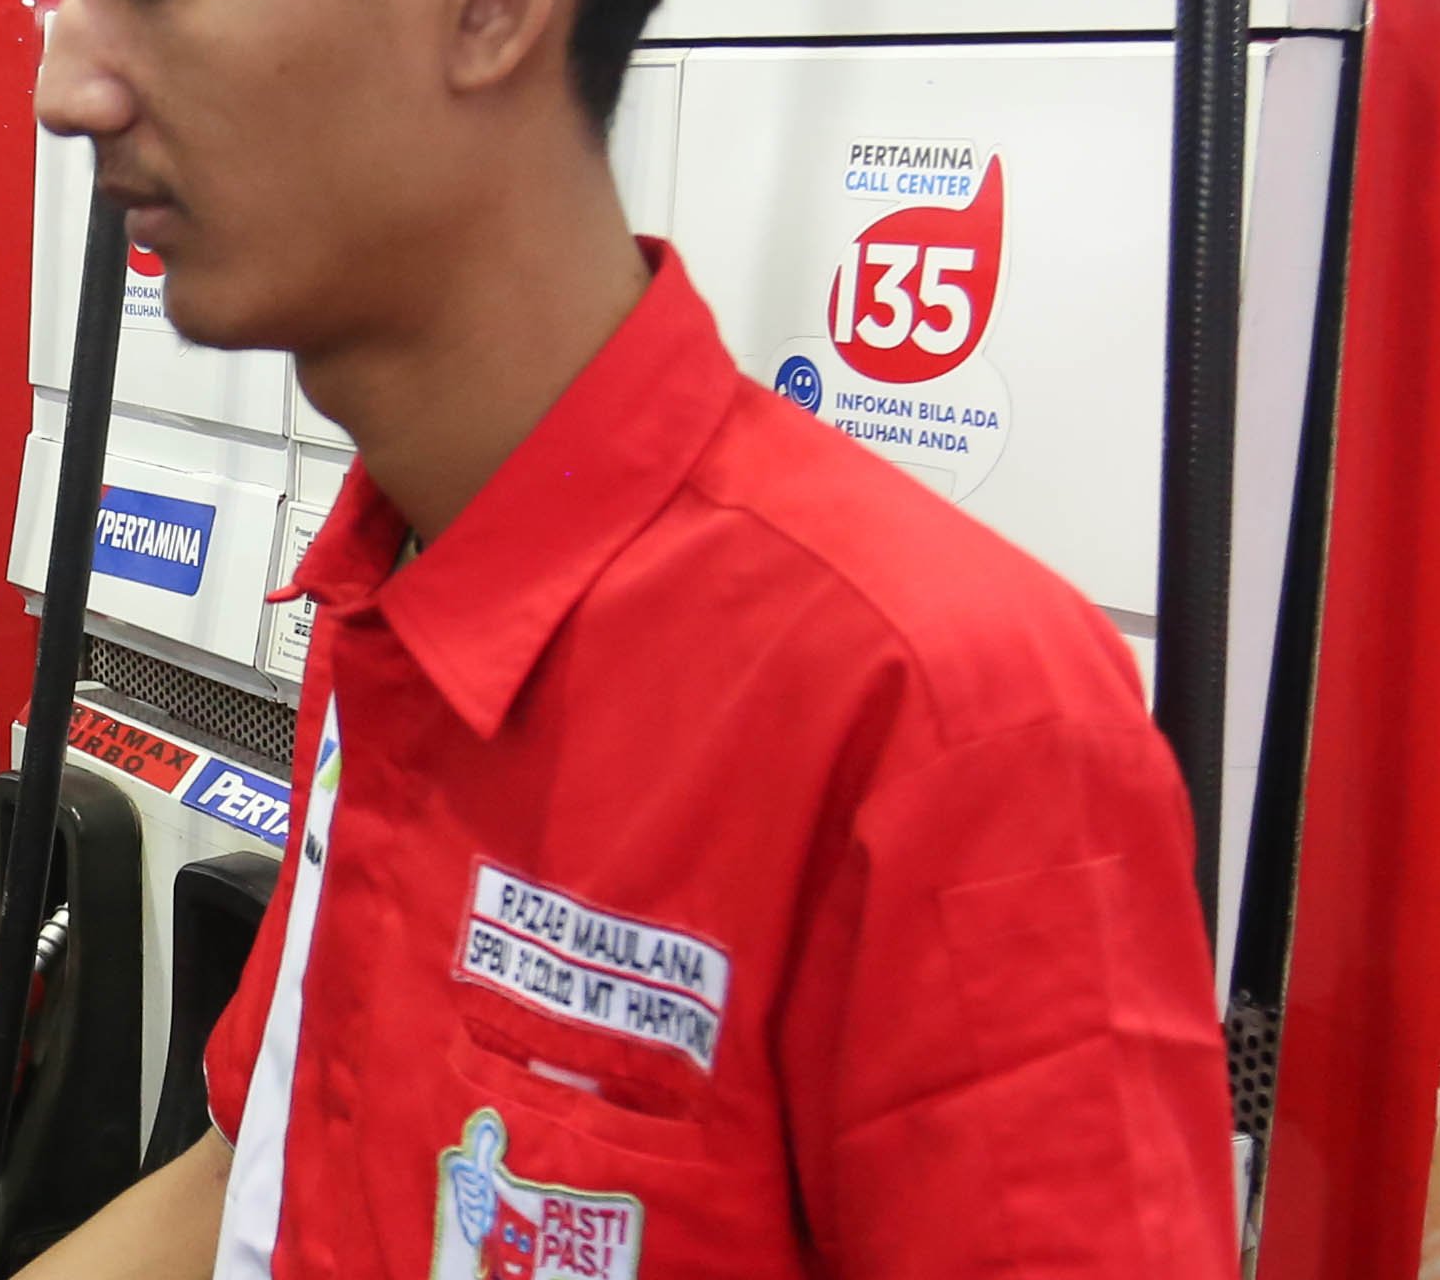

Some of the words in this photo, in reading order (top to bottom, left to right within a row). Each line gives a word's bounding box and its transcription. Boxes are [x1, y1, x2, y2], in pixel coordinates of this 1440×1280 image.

[850, 144, 973, 170] PERTAMINA
[845, 171, 889, 193] CALL
[897, 173, 971, 197] CENTER
[834, 242, 975, 355] 135
[836, 392, 912, 418] INFOKAN
[918, 401, 957, 424] BILA
[962, 408, 999, 430] ADA
[835, 419, 912, 445] KELUHAN
[918, 428, 969, 454] ANDA
[68, 731, 145, 775] URBO
[71, 706, 190, 772] RTAMAX
[470, 929, 511, 975] SPBU
[583, 974, 614, 1019] MT
[574, 913, 705, 991] MAULANA
[542, 1197, 629, 1245] PASTI
